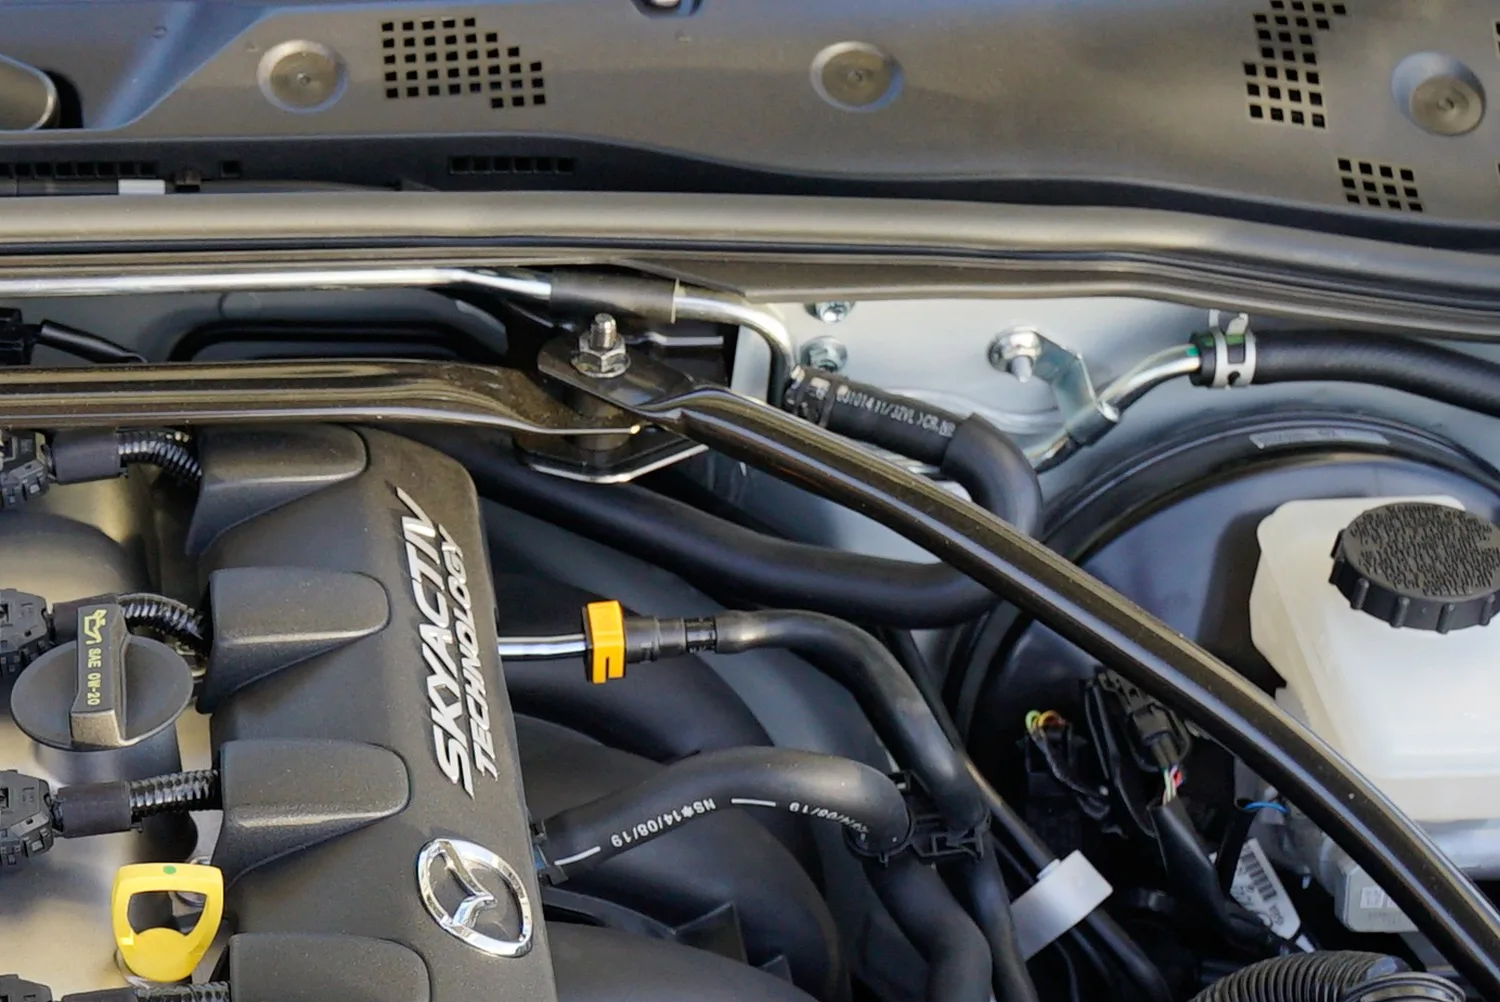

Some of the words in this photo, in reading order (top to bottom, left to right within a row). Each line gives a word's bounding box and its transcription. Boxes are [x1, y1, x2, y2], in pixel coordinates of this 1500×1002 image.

[87, 648, 102, 668] SAE
[87, 672, 101, 706] 0W-20
[397, 487, 475, 800] SKYACTIV
[438, 523, 499, 782] TECHNOLOGY
